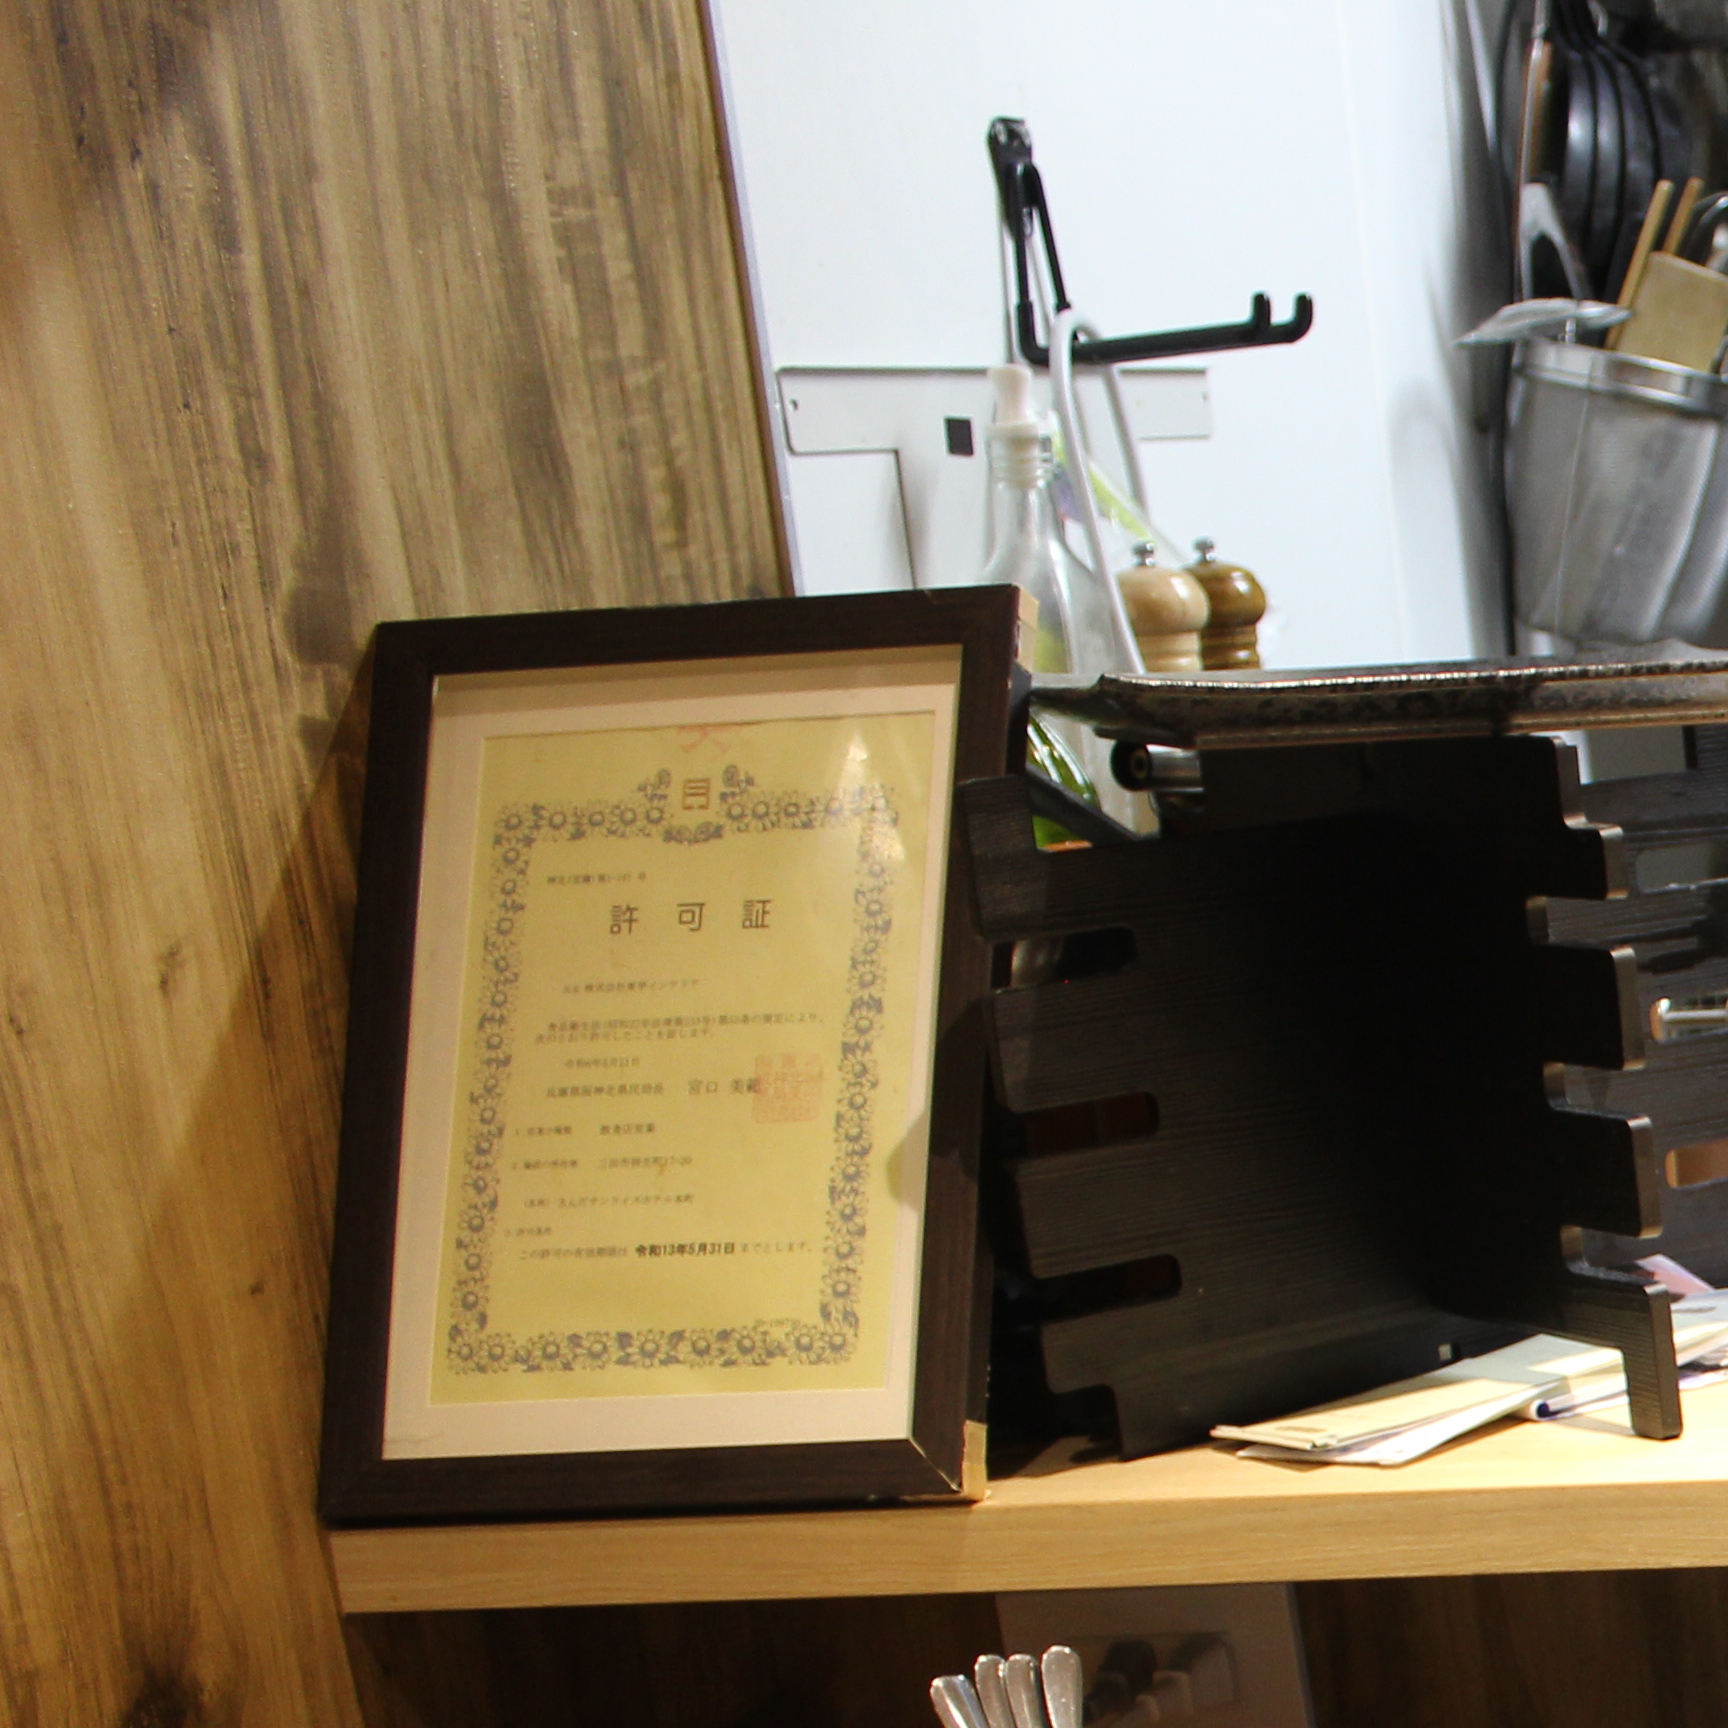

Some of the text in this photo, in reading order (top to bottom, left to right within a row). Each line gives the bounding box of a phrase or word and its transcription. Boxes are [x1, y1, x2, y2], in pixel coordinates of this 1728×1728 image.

[609, 899, 772, 935] 許可証
[635, 1242, 735, 1258] 令和13年5月31日
